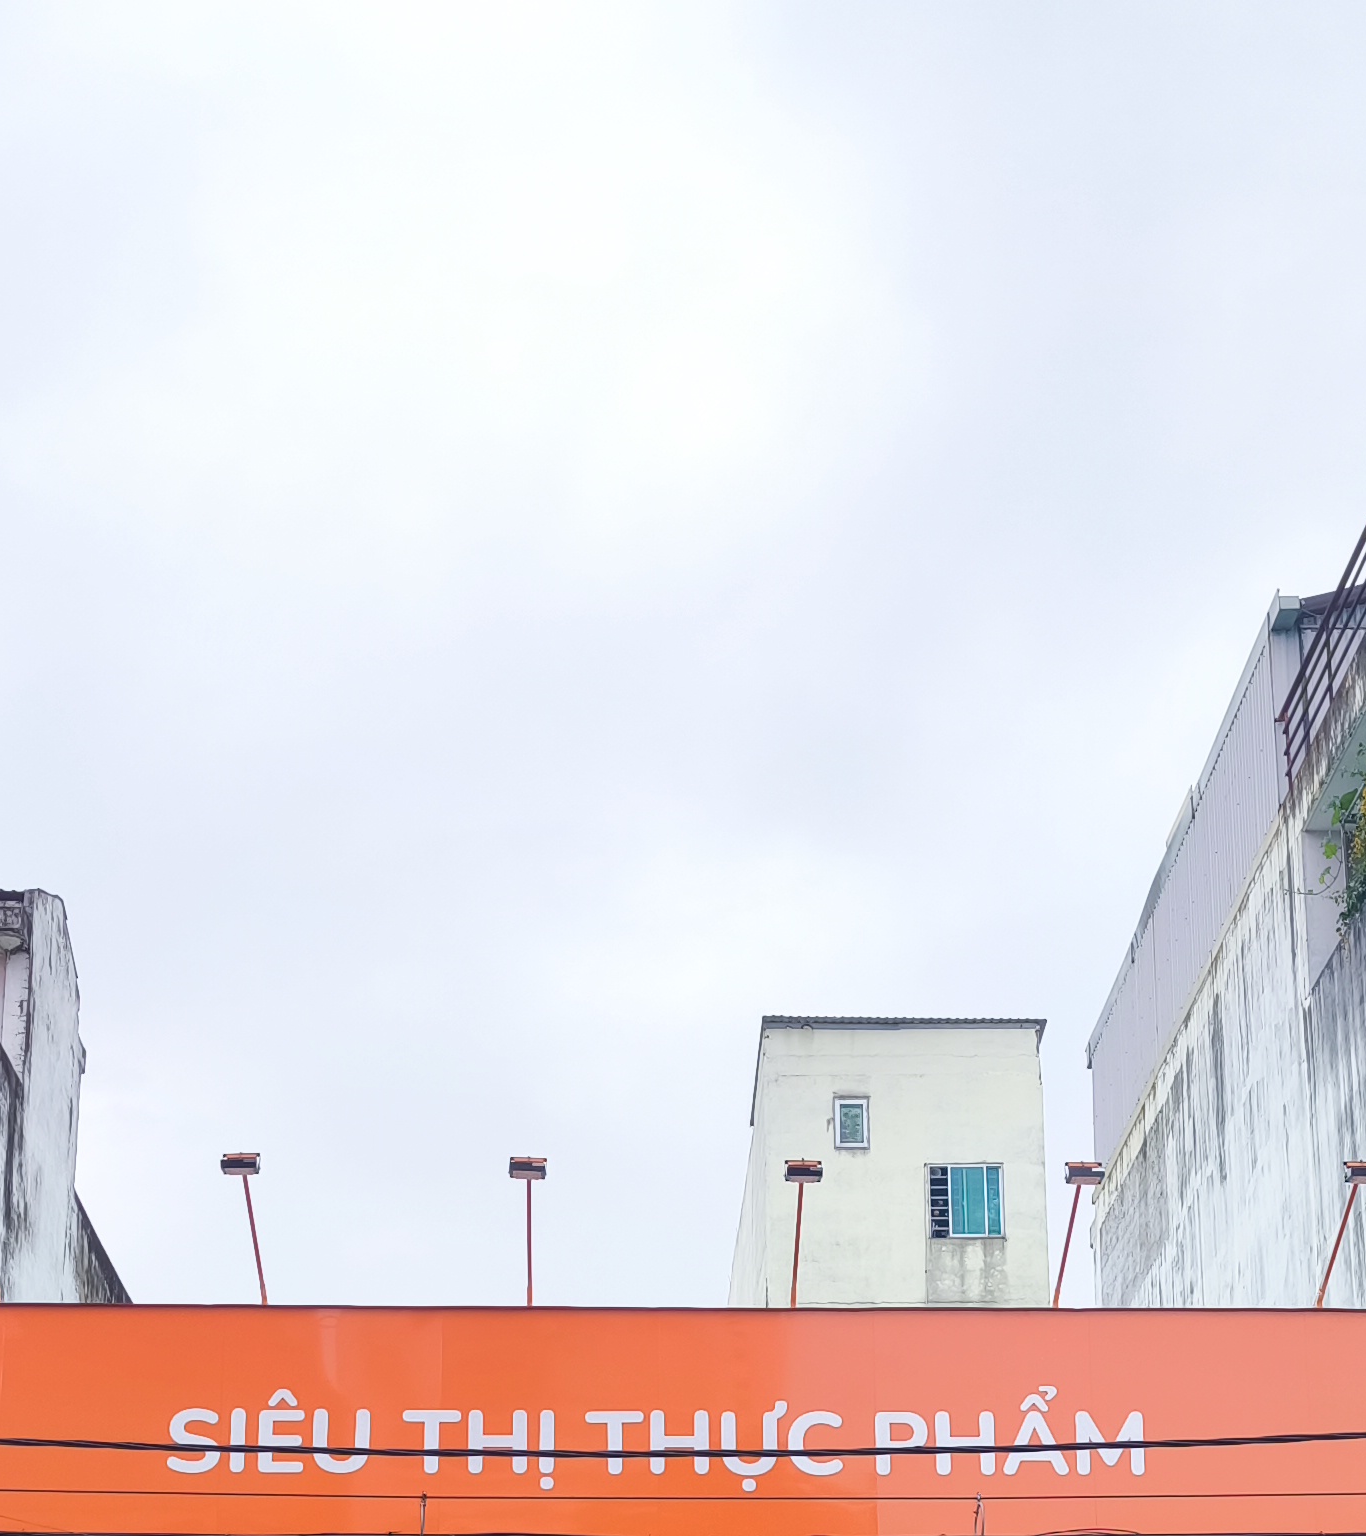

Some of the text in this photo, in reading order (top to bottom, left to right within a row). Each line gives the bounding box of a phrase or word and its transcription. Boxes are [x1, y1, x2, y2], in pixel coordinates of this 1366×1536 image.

[166, 1385, 1146, 1492] SIÊU THỊ THỰC PHẨM
